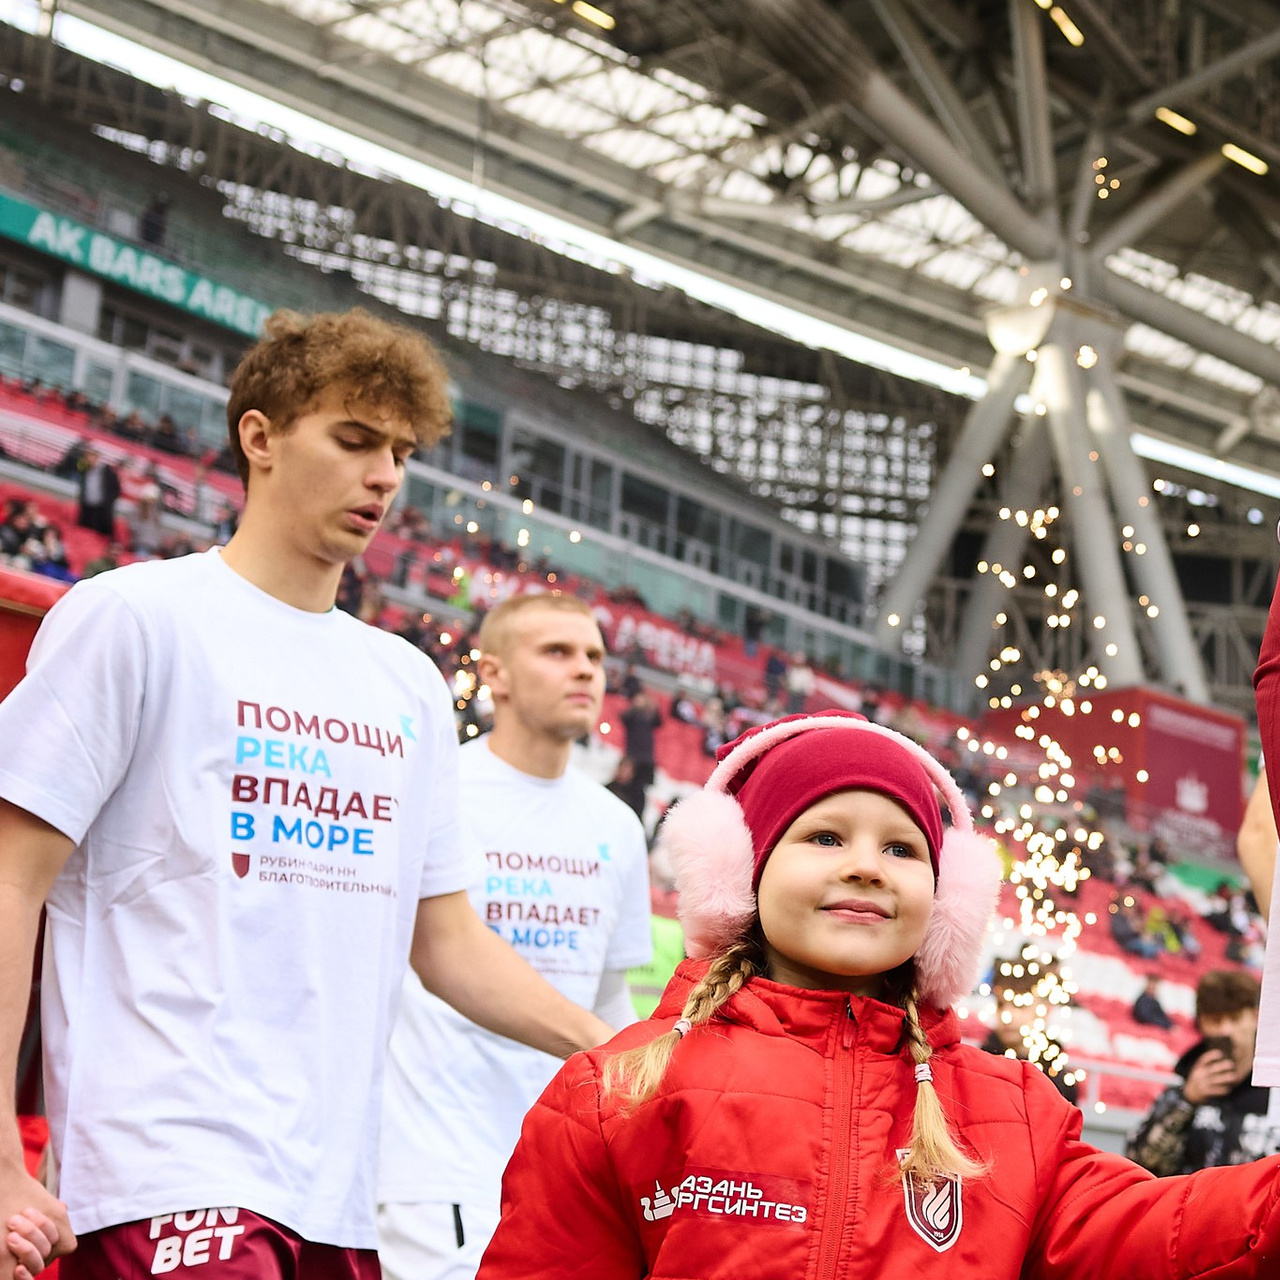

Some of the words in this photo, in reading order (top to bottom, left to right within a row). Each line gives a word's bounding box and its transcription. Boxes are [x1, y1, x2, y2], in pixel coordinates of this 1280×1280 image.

[27, 210, 87, 262] AK
[88, 233, 188, 305] BARS
[186, 276, 276, 340] ARE
[237, 699, 405, 759] ПОМОЩИ
[234, 735, 333, 780] РЕКА
[231, 774, 400, 823] ВПАДАЕ
[230, 811, 256, 841] В
[272, 814, 375, 856] МОРЕ
[485, 851, 600, 877] ПОМОЩИ
[486, 875, 553, 897] РЕКА
[486, 900, 600, 927] ВПАДАЕТ
[511, 927, 580, 951] МОРЕ
[679, 1174, 764, 1200] АЗАНЬ
[676, 1192, 808, 1224] РГСИНТЕЗ
[150, 1225, 246, 1276] BET
